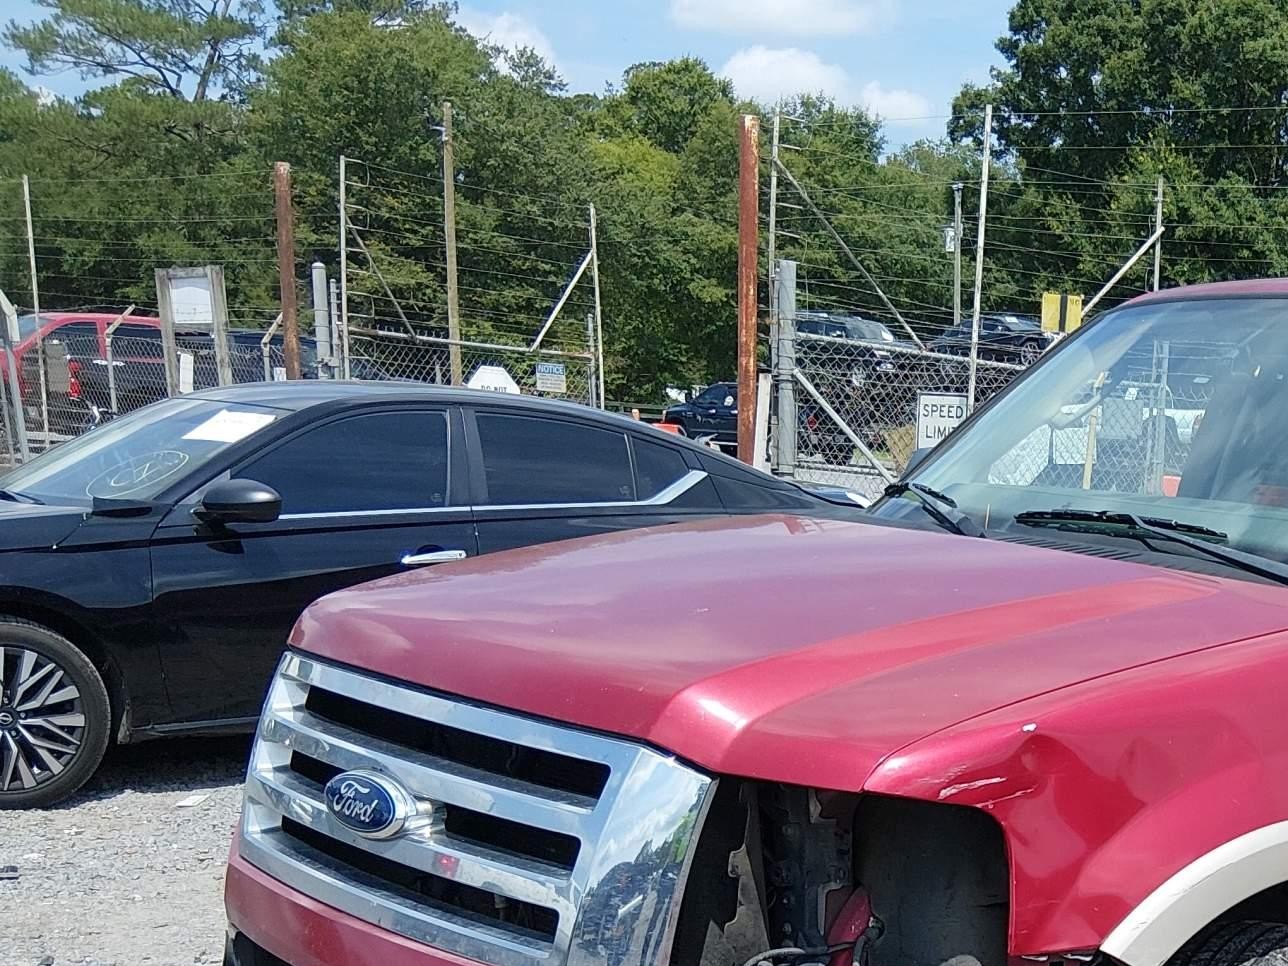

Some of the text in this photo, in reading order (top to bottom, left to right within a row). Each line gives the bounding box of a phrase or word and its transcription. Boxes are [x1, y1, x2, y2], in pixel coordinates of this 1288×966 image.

[537, 364, 564, 375] NOTICE
[922, 403, 964, 419] SPEED
[333, 780, 379, 823] Ford
